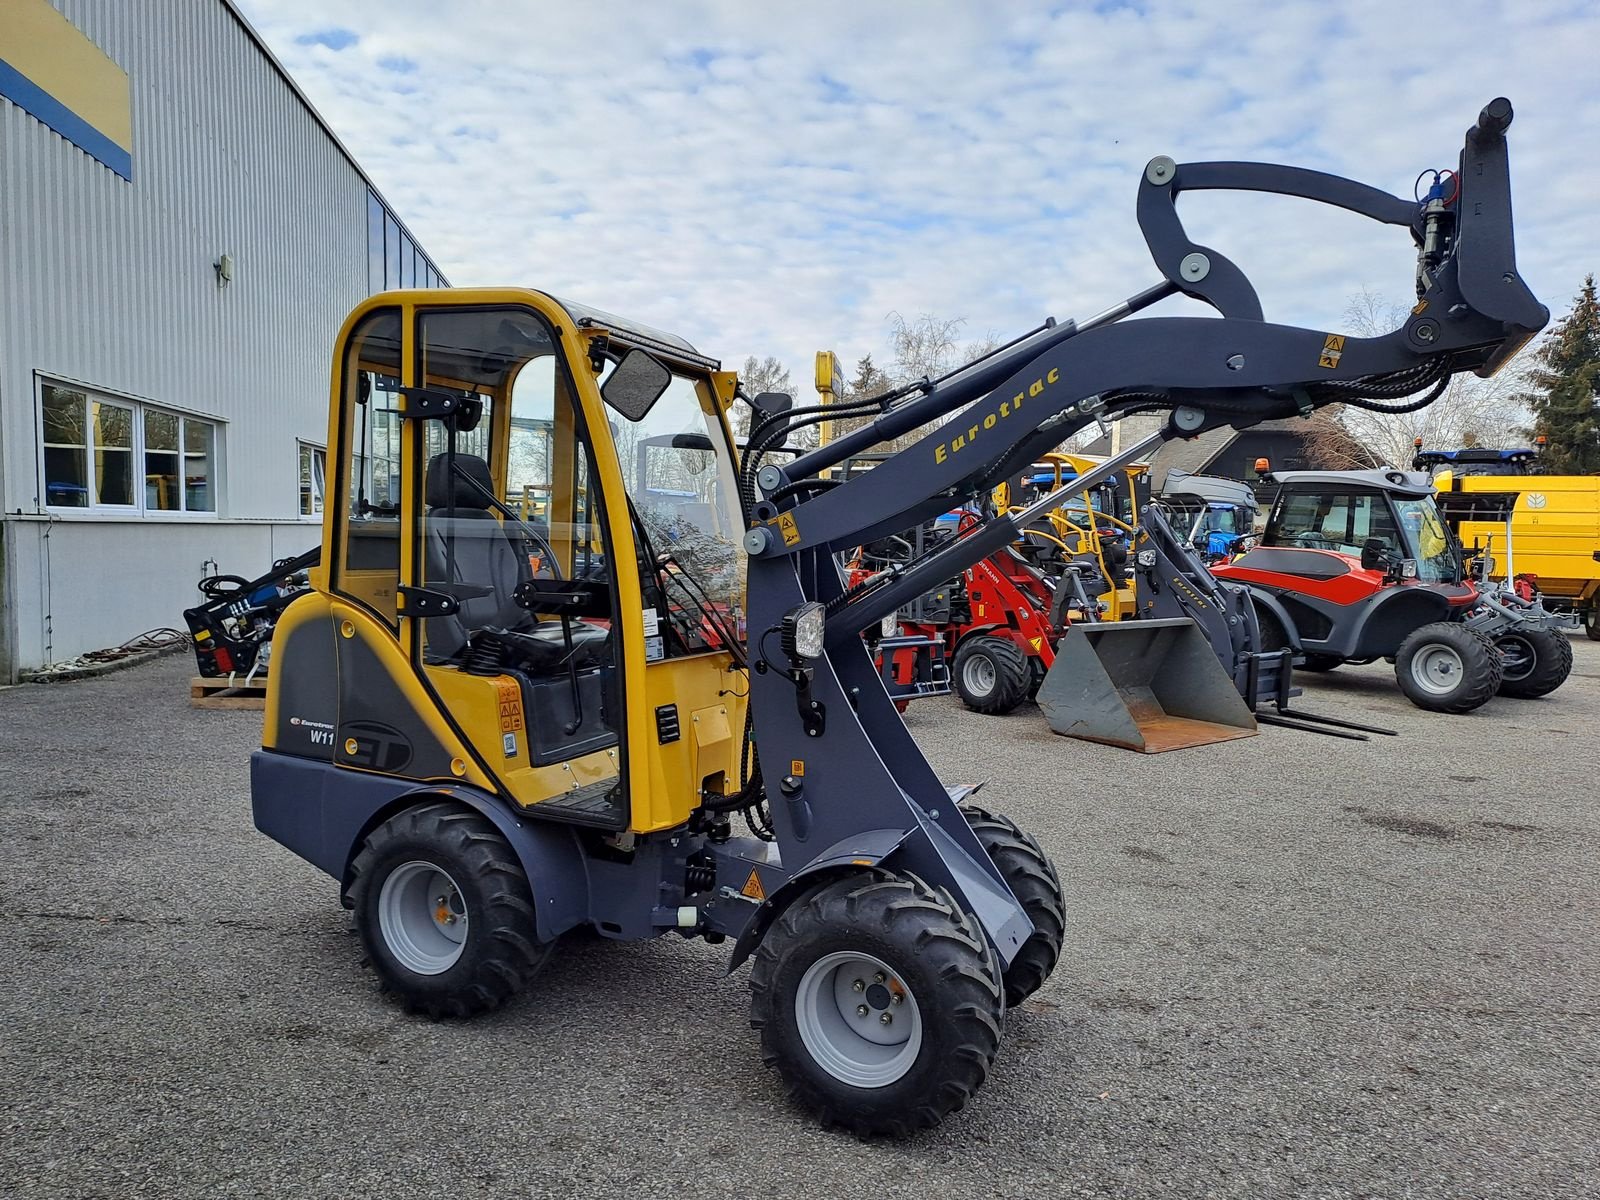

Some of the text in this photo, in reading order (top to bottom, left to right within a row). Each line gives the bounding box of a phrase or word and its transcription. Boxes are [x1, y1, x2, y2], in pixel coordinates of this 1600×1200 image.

[934, 367, 1060, 465] Eurotrac
[978, 560, 1000, 585] DEMANN
[1173, 577, 1208, 609] Eurotrac
[301, 719, 335, 730] Eurotrac
[310, 729, 335, 746] W11
